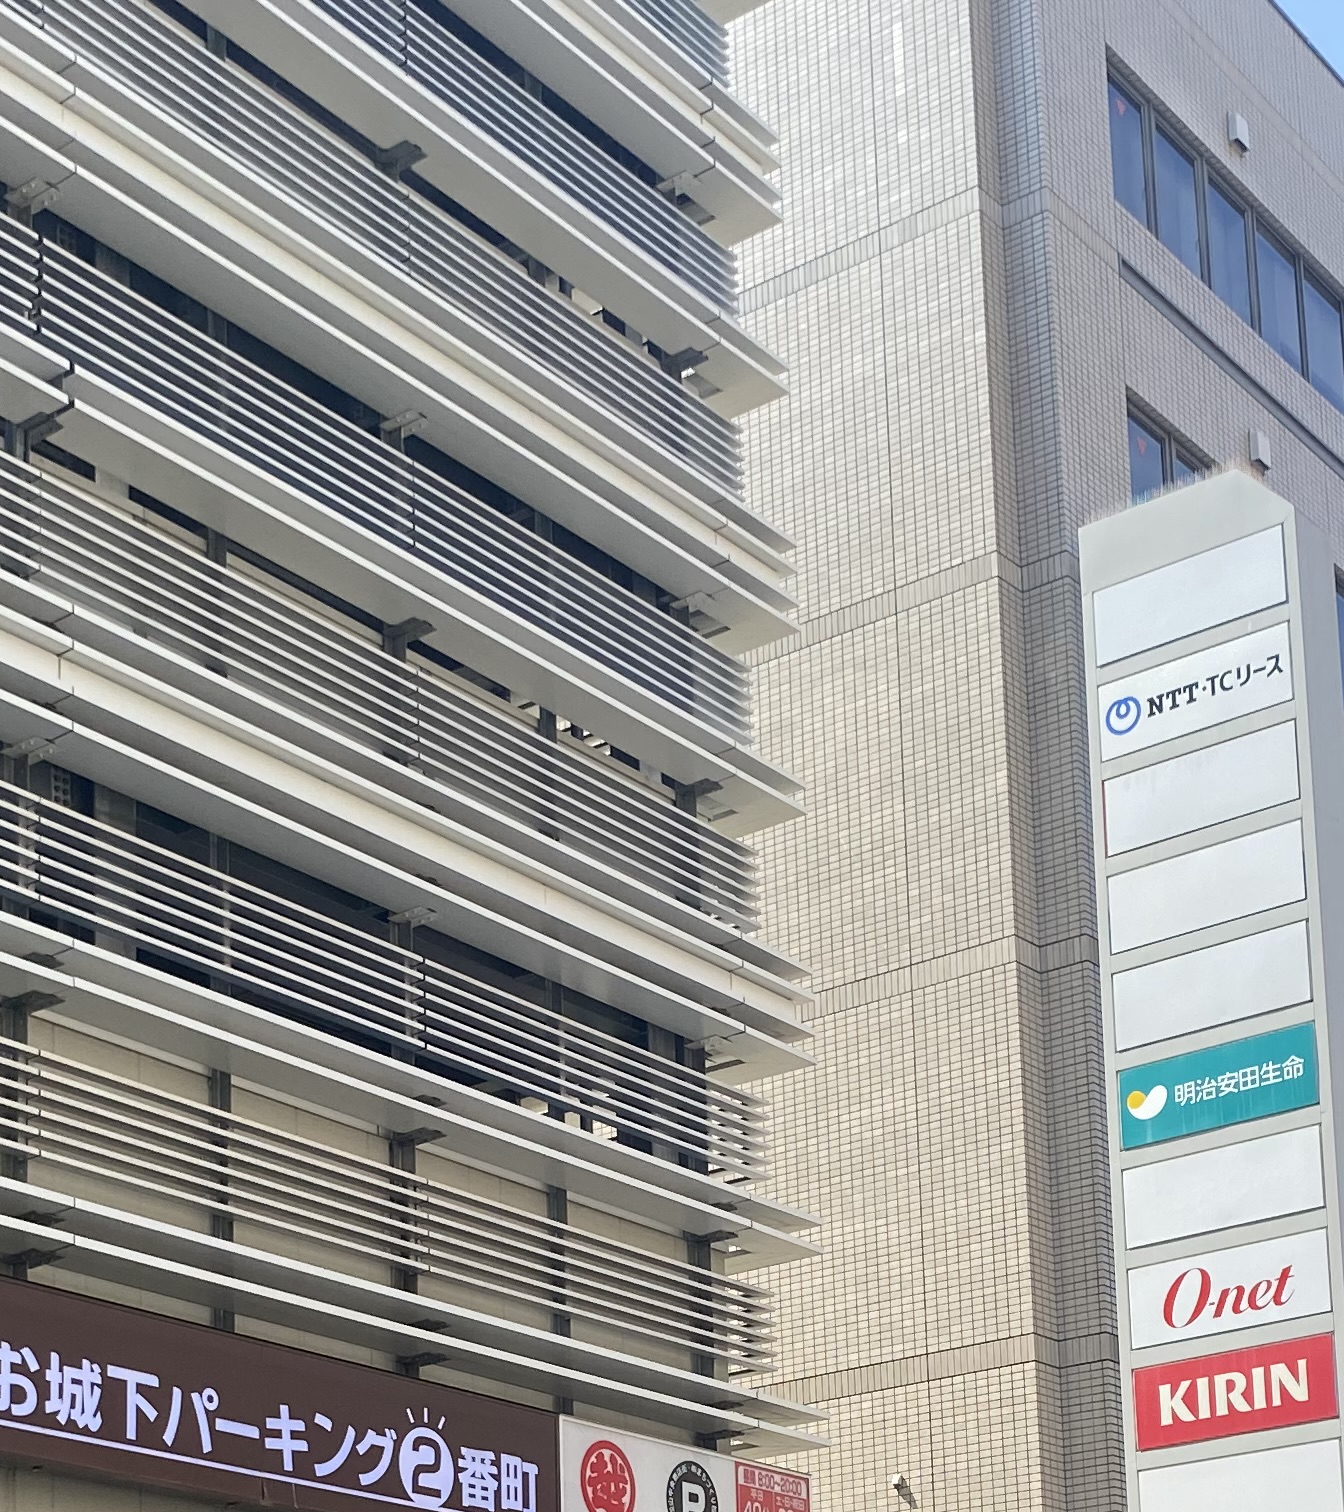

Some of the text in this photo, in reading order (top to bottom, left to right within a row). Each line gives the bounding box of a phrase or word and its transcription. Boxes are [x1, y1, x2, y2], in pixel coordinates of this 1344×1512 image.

[1174, 1055, 1304, 1106] 明治安田生命
[1163, 1264, 1295, 1328] O-net
[1158, 1358, 1309, 1427] KIRIN
